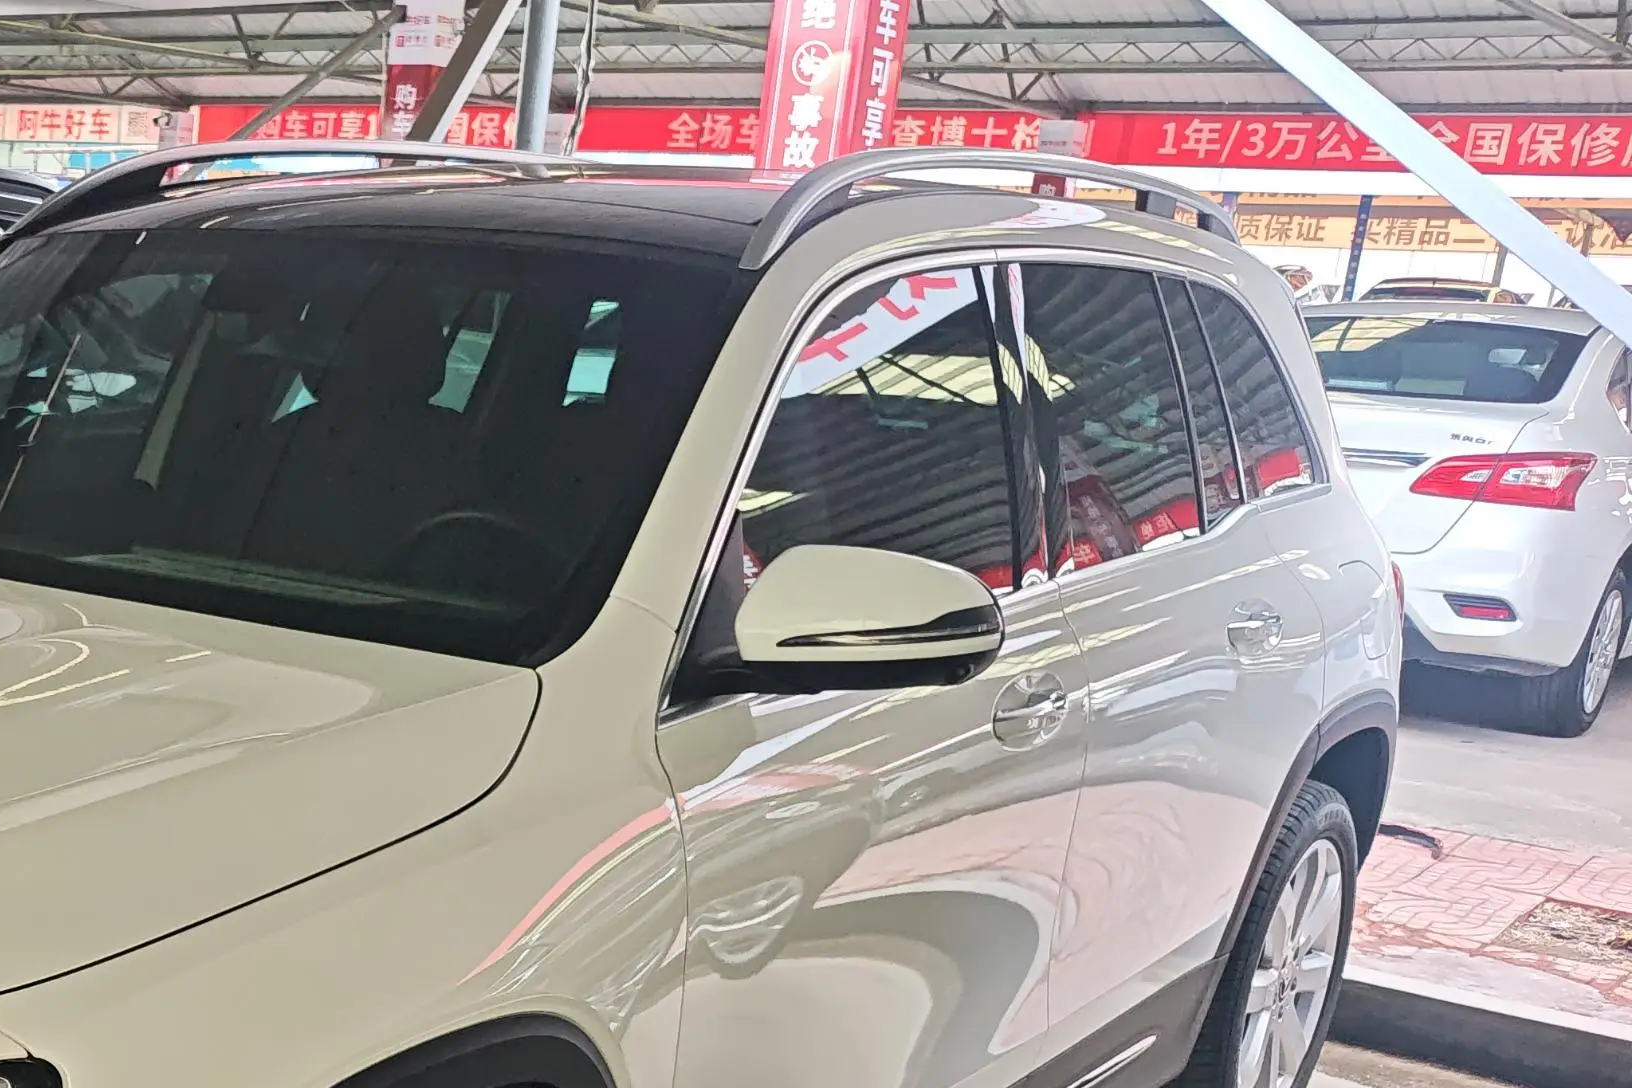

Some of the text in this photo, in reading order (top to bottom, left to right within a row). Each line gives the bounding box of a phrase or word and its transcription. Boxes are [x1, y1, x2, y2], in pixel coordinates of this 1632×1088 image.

[17, 107, 113, 141] 阿牛好车
[666, 111, 760, 151] 全场车
[782, 93, 825, 168] 事故
[892, 115, 1096, 158] 查博士检
